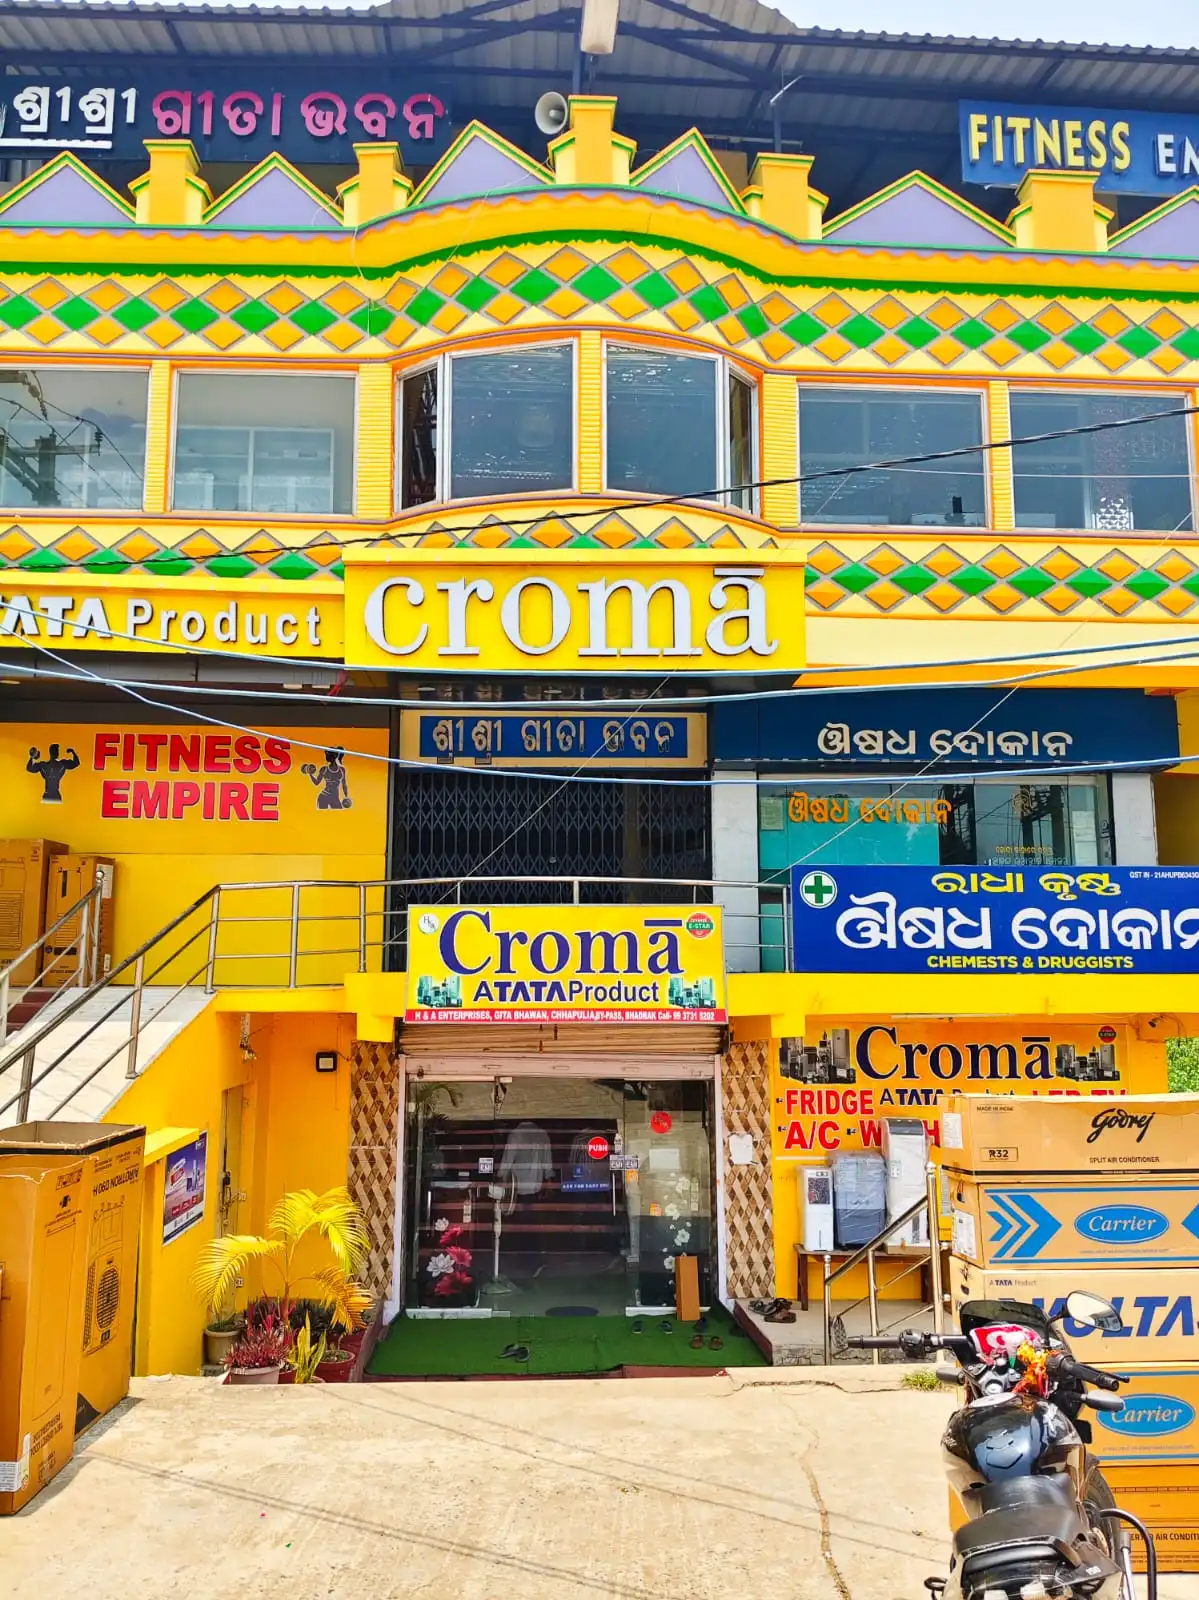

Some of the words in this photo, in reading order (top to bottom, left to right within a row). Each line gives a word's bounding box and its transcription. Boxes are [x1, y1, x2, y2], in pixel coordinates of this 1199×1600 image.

[152, 89, 282, 137] ଗୀତା
[301, 90, 445, 139] ଭବନ
[968, 113, 1131, 172] FITNESS
[0, 595, 112, 638] ATA
[127, 599, 320, 646] Product
[94, 733, 292, 774] FITNESS
[816, 722, 917, 757] ଔଷଧ
[929, 728, 1074, 757] ଦୋକାନ
[101, 780, 280, 821] EMPIRE
[931, 872, 1025, 895] ରାଧା
[1038, 872, 1122, 901] କୃଷ୍ଣ
[835, 891, 993, 950] ଔଷଧ
[927, 955, 1018, 969] CHEMESTS
[1022, 956, 1034, 969] &
[1038, 956, 1134, 969] DRUGGISTS
[786, 1089, 874, 1115] FRIDGE
[880, 1088, 895, 1105] A
[784, 1120, 841, 1150] A/C
[1087, 1108, 1156, 1143] Godrej
[988, 1149, 1009, 1158] R32
[1088, 1215, 1157, 1232] Carrier
